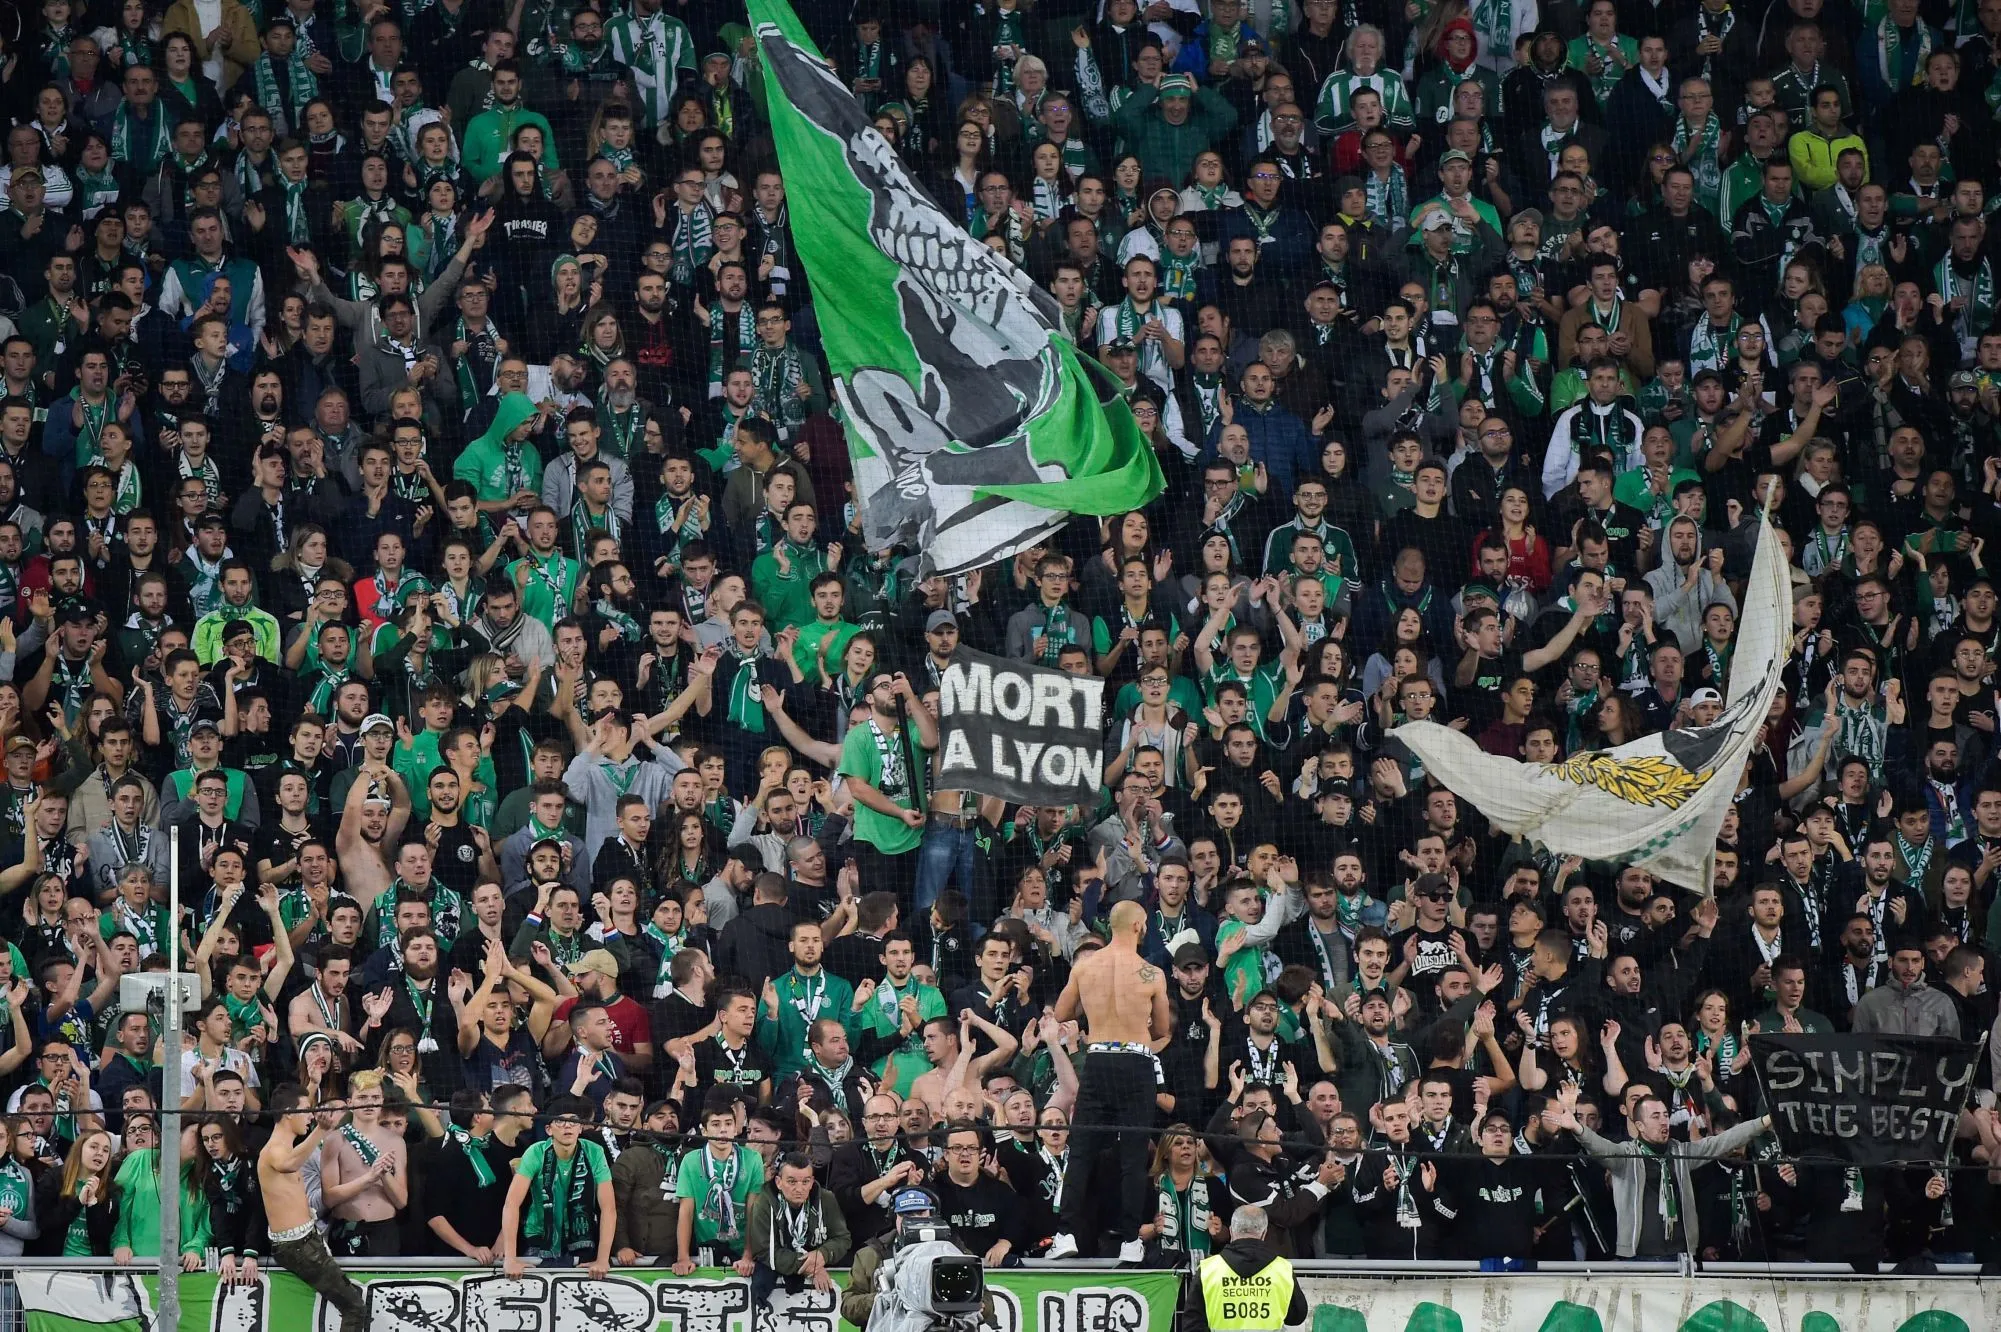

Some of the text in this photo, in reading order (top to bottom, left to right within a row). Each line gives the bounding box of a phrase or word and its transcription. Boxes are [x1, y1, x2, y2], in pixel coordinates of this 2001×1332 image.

[940, 662, 1105, 730] MORT
[941, 729, 1103, 792] A LYON
[1766, 1050, 1973, 1101] SIMPLY
[1778, 1101, 1957, 1144] THE BEST
[1222, 1276, 1271, 1287] BYBLOS
[1222, 1288, 1271, 1297] SECURITY
[1223, 1302, 1270, 1319] B085
